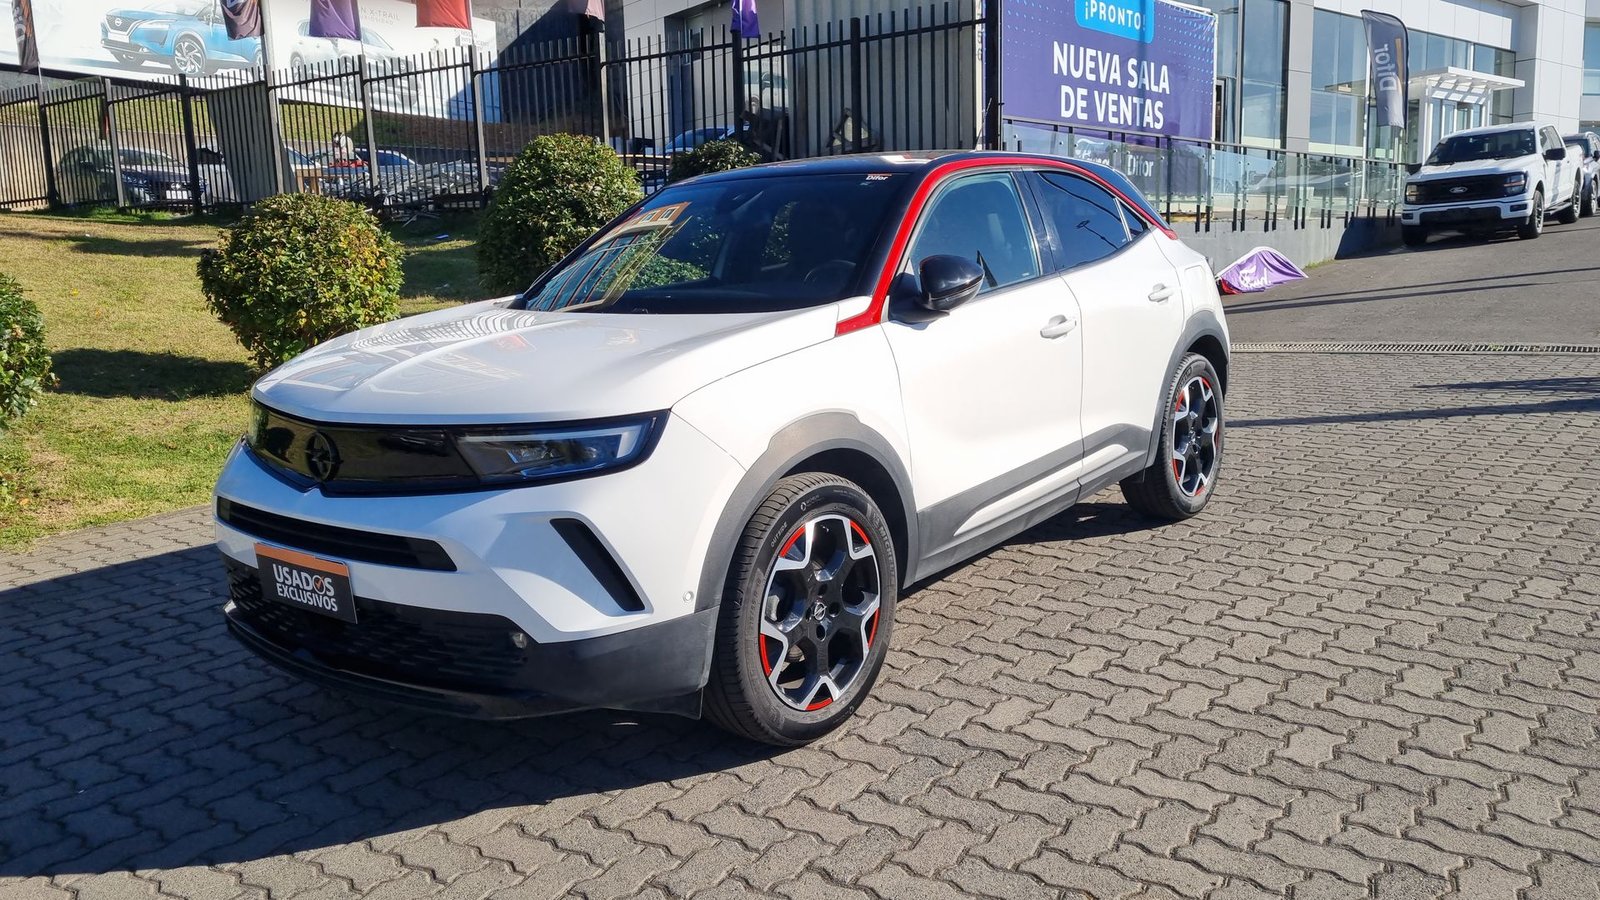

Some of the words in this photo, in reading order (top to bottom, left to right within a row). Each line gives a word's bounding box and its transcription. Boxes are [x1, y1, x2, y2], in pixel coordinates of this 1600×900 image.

[1084, 0, 1146, 31] ¡PRONTO!
[1053, 41, 1121, 86] NUEVA
[1127, 58, 1170, 94] SALA
[1061, 85, 1088, 120] DE
[1094, 90, 1164, 129] VENTAS
[272, 563, 335, 597] USADOS
[276, 582, 338, 612] EXCLUSIVOS
